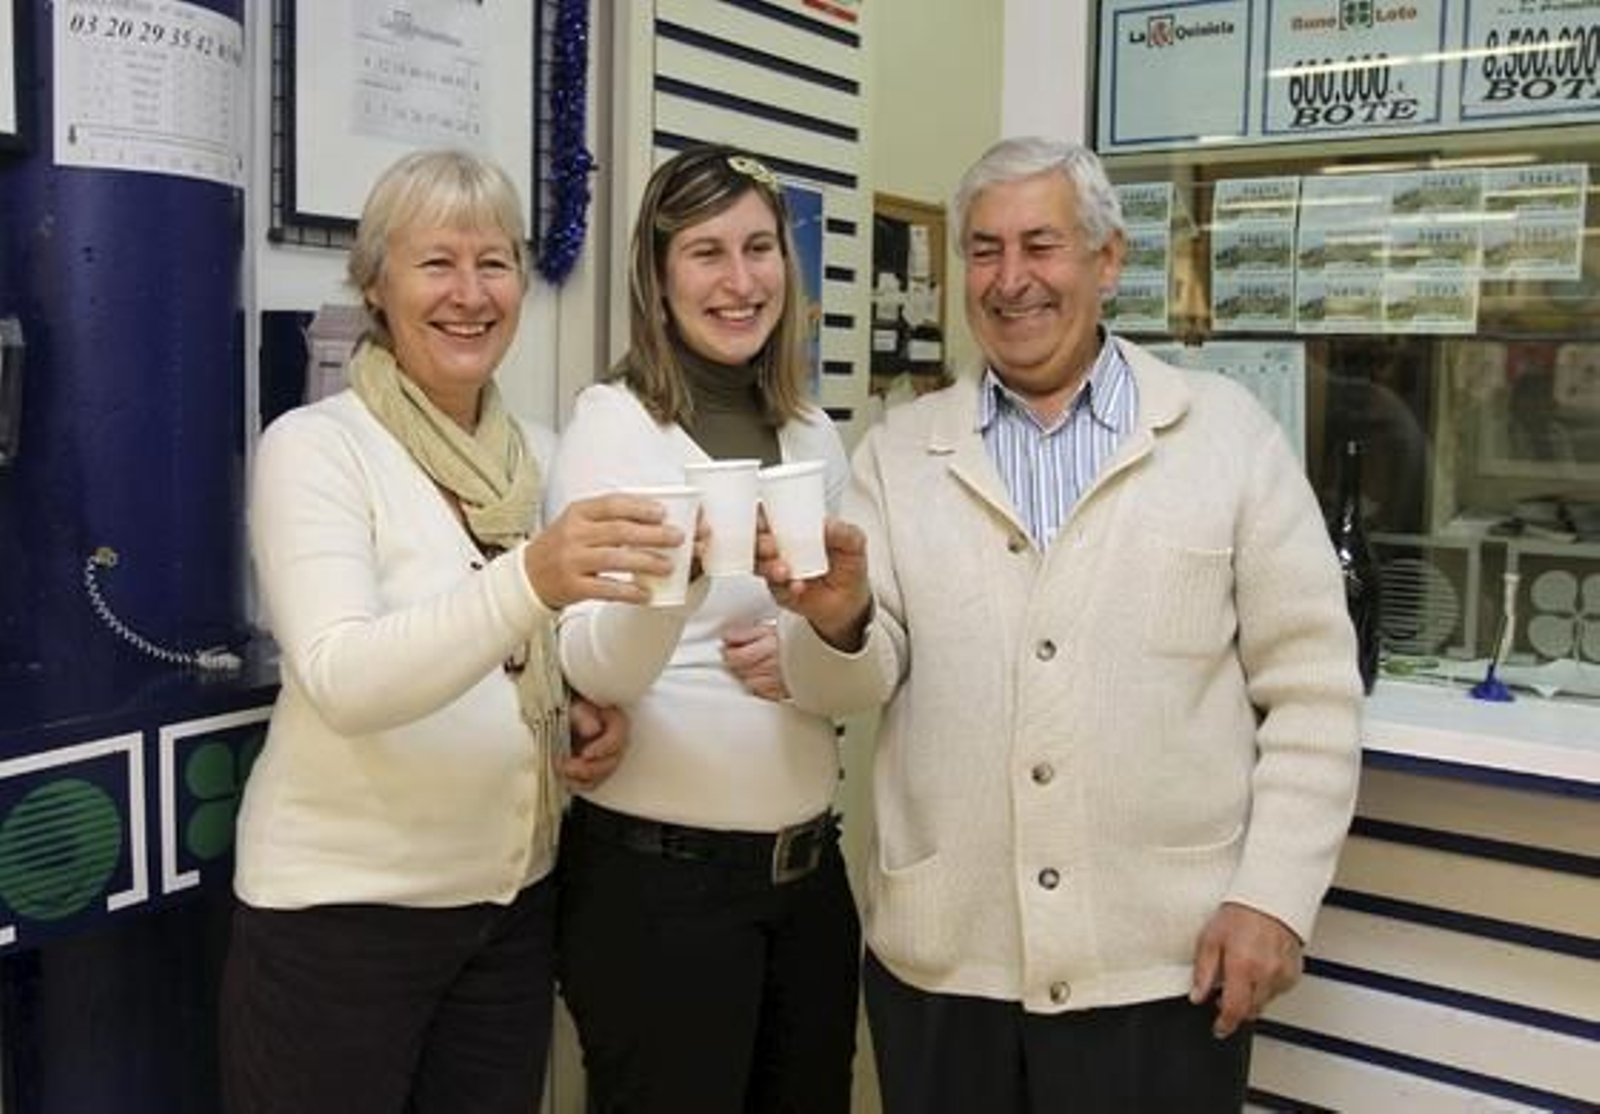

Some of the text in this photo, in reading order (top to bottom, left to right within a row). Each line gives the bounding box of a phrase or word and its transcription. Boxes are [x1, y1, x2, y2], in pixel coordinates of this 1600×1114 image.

[1375, 7, 1417, 23] Loto
[69, 14, 97, 34] 03
[104, 17, 134, 39] 20
[138, 21, 165, 45] 29
[169, 27, 191, 49] 35
[1129, 30, 1146, 43] La
[1289, 98, 1418, 128] BOTE
